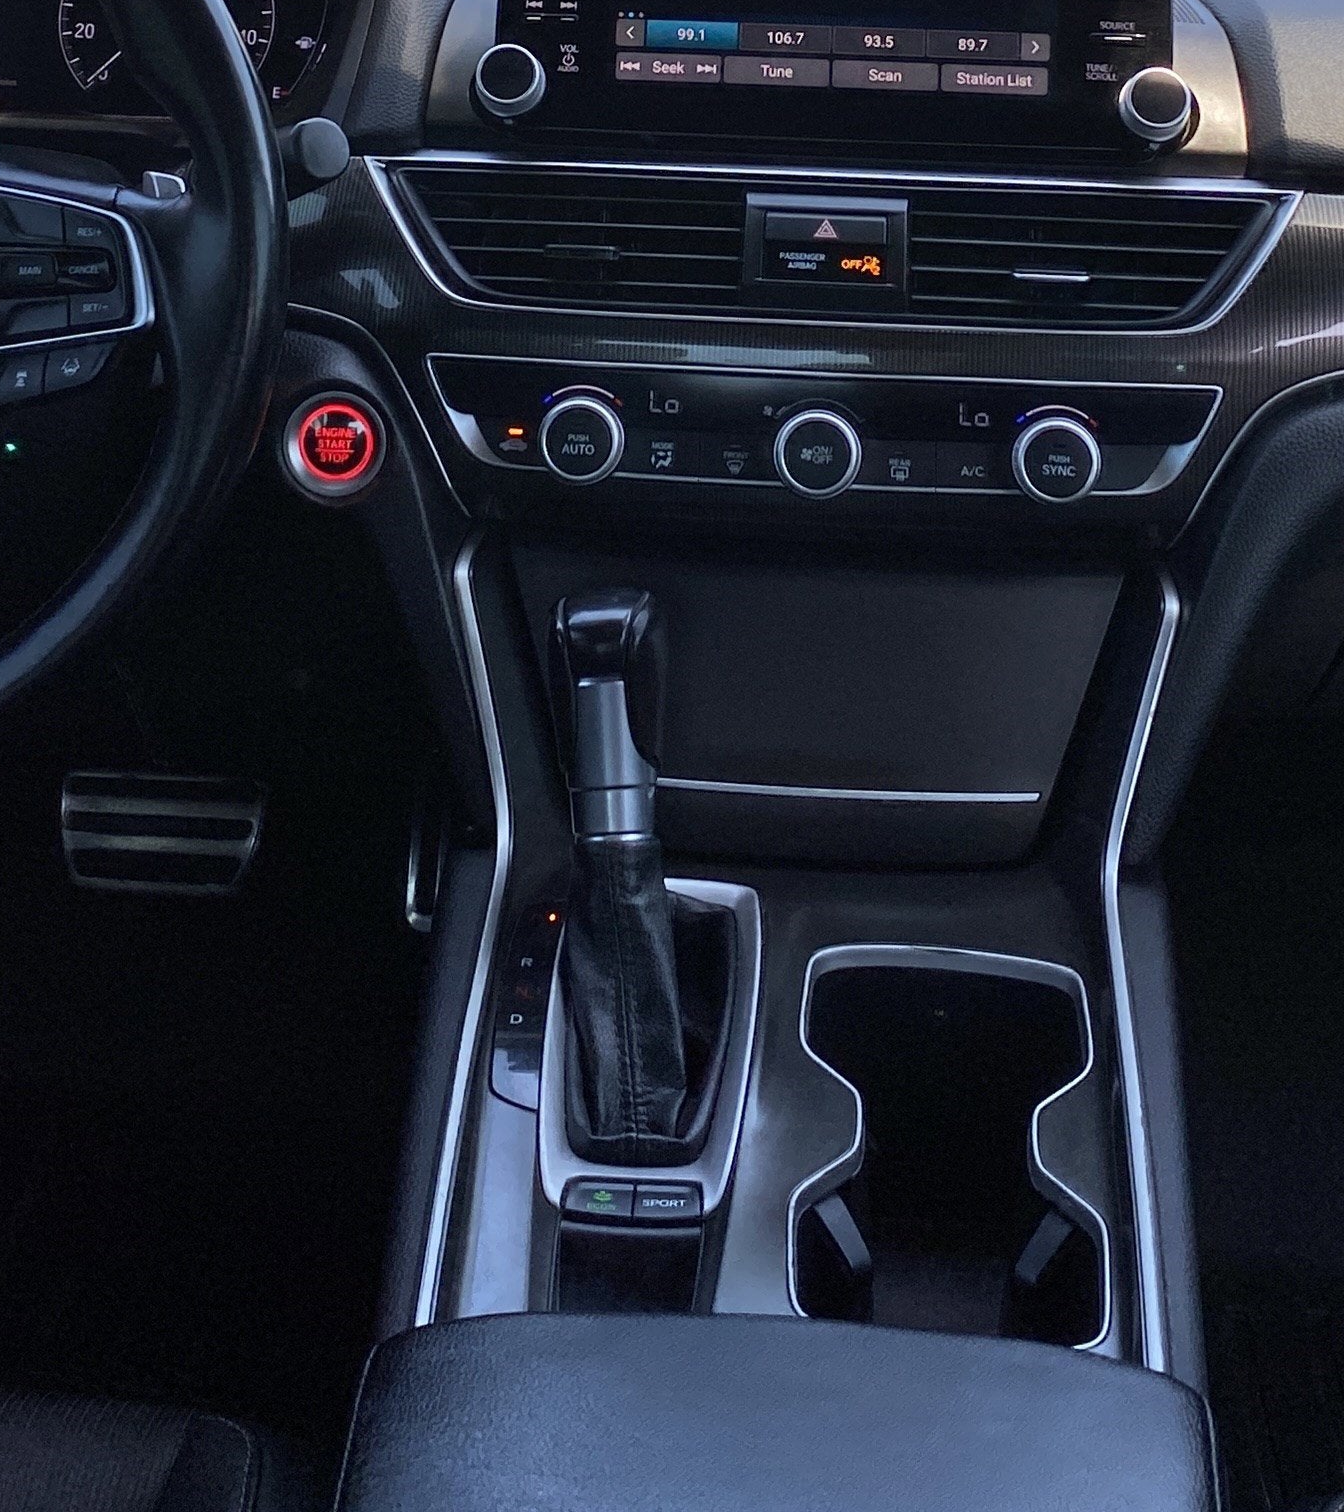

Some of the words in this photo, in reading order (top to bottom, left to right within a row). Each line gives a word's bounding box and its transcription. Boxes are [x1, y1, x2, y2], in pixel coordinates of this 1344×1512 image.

[74, 22, 95, 40] 20
[1099, 20, 1136, 32] SOURCE
[677, 28, 706, 42] 99.1
[766, 31, 804, 46] 106.7
[863, 34, 894, 48] 93.5
[957, 38, 988, 52] 89.7
[560, 44, 580, 54] VOL
[652, 60, 685, 75] Seek
[761, 64, 793, 79] Tune
[868, 68, 902, 83] Scan
[956, 72, 1005, 87] Station
[1007, 73, 1032, 88] List
[272, 86, 281, 100] E
[779, 251, 826, 262] PASSENGER
[787, 261, 817, 271] AIRBAG
[841, 259, 863, 270] OFF
[18, 266, 42, 276] MAIN
[68, 265, 99, 275] CANCEL
[649, 390, 680, 414] Lo
[959, 402, 991, 428] Lo
[315, 427, 356, 439] ENGINE
[567, 434, 590, 442] PUSH
[318, 439, 352, 450] START
[561, 443, 596, 457] AUTO
[650, 442, 674, 451] MODE
[722, 451, 750, 460] FRONT
[812, 445, 833, 456] ON/
[319, 452, 350, 463] STOP
[811, 454, 834, 465] OFF
[888, 457, 912, 468] REAR
[1047, 454, 1071, 464] PUSH
[960, 464, 986, 478] A/C
[1041, 463, 1077, 478] SYNC
[520, 957, 533, 967] R
[510, 1013, 522, 1024] D
[641, 1198, 687, 1209] SPORT
